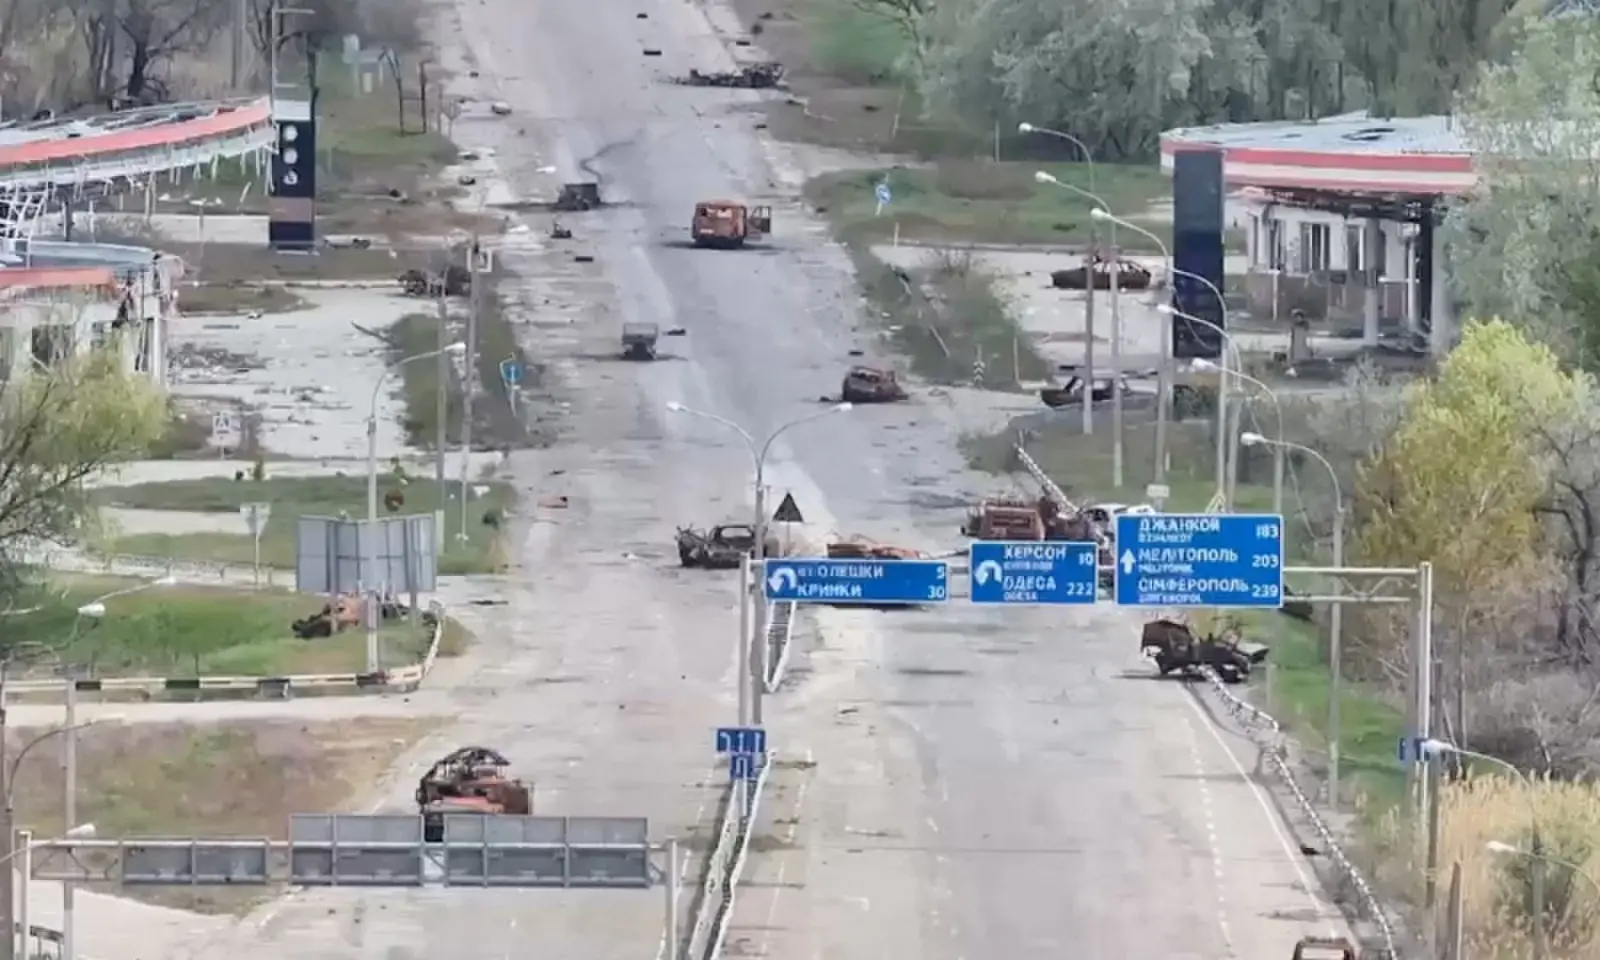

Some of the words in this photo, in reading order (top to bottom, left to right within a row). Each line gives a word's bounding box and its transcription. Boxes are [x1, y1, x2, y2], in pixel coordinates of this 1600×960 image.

[1255, 523, 1279, 539] 183
[1004, 545, 1067, 560] ХЕРСОН
[1078, 552, 1094, 567] 10
[1139, 547, 1239, 563] МЕЛІТОПОЛЬ
[1252, 554, 1279, 568] 203
[936, 565, 946, 579] 5
[797, 582, 863, 598] КРИНКИ
[927, 585, 946, 600] 30
[1003, 575, 1057, 591] ОДЕСА
[1067, 582, 1094, 596] 222
[1138, 577, 1250, 593] СІМФЕРОПОЛЬ
[1251, 584, 1279, 598] 239
